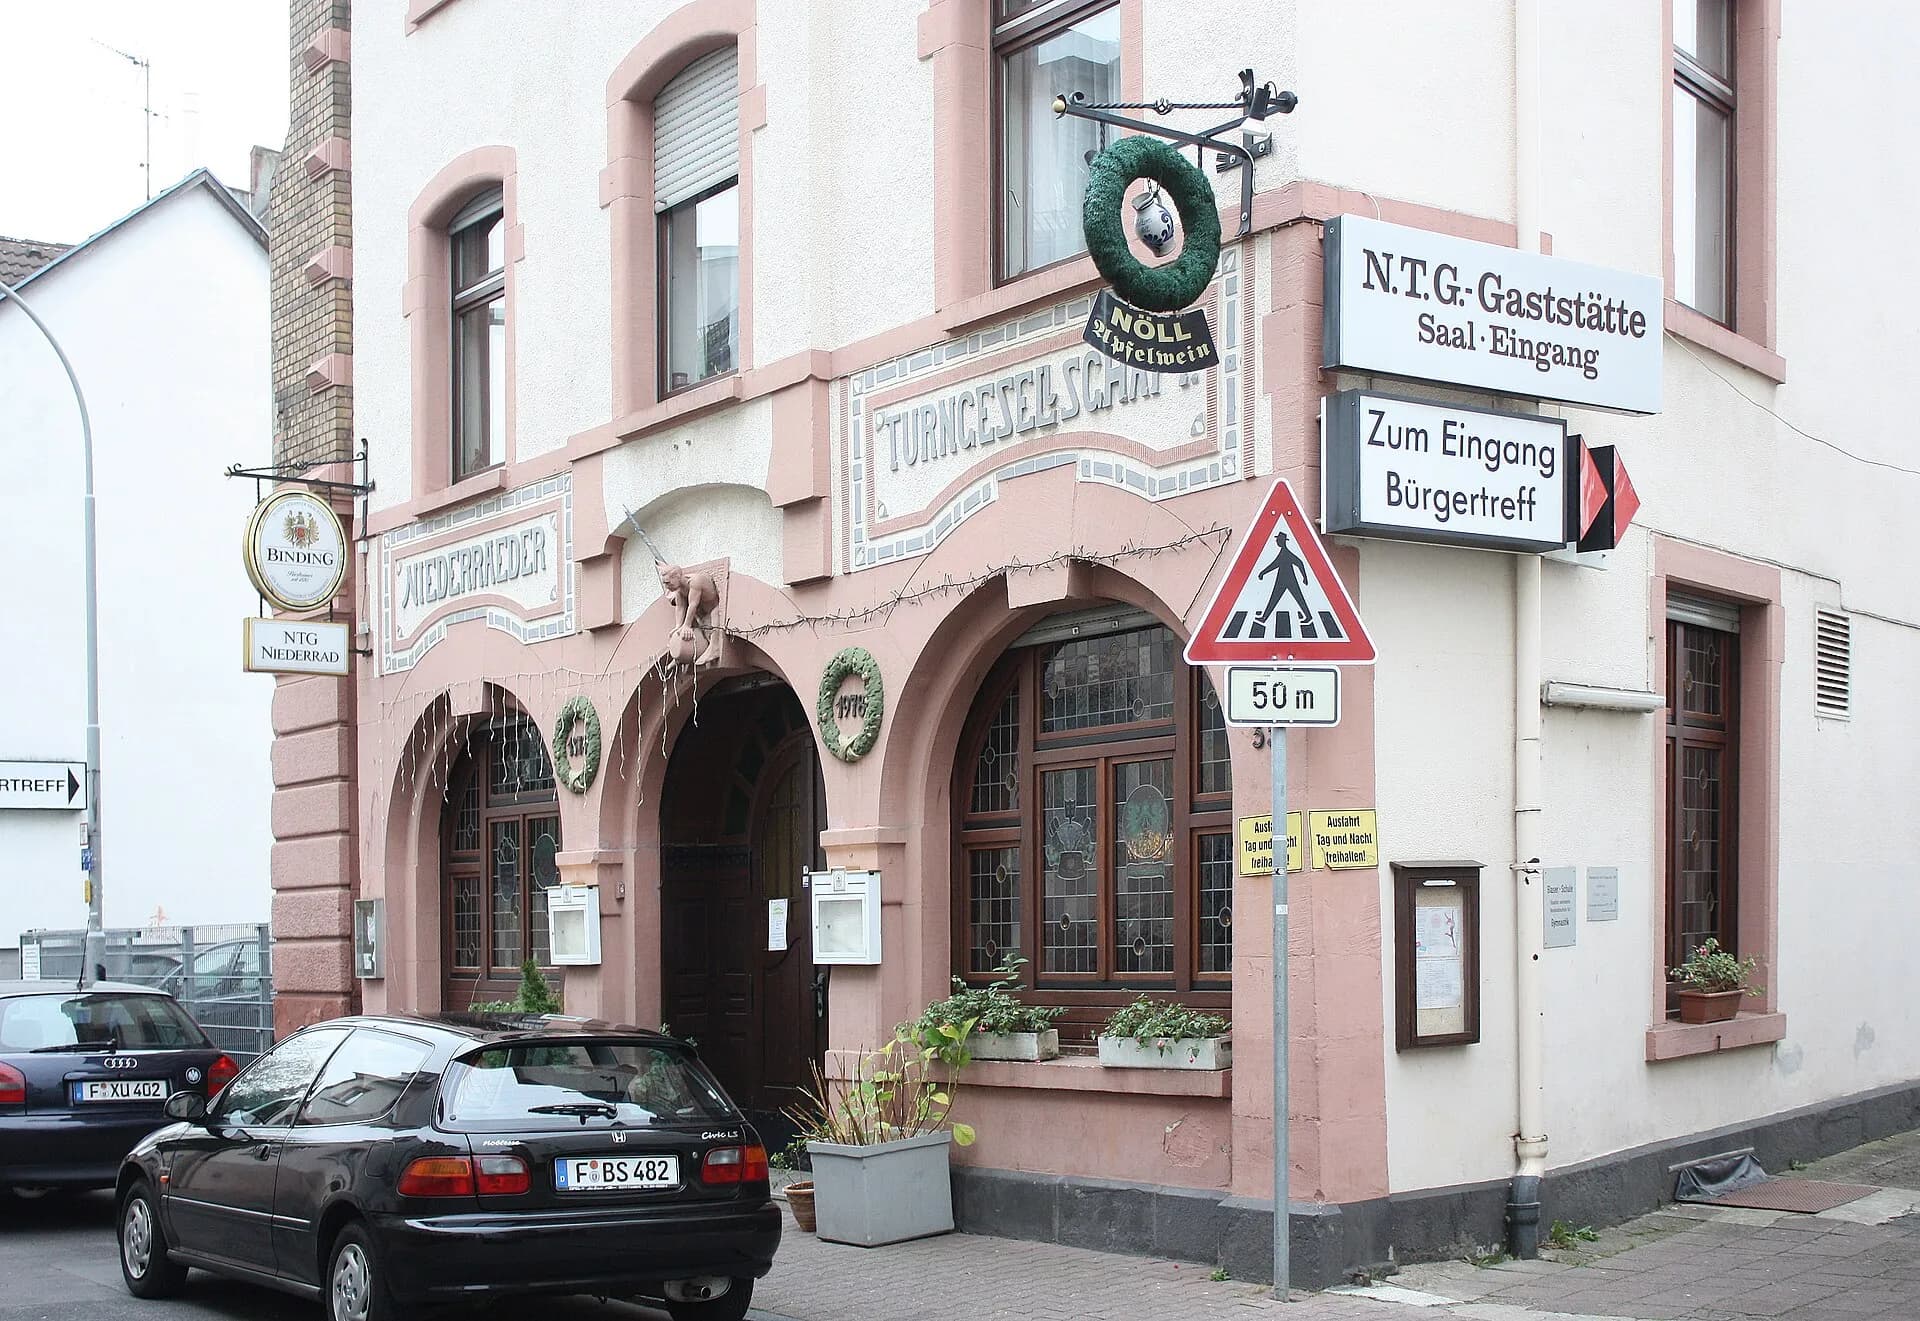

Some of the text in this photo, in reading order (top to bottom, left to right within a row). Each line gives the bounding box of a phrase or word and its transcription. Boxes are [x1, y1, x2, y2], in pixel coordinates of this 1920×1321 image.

[1110, 306, 1192, 343] NÖLL
[1091, 318, 1211, 367] Apfelwein
[1418, 312, 1600, 380] Saal Eingang
[1367, 409, 1555, 479] Zum Eingang
[1386, 470, 1537, 523] Bürgertreff
[401, 525, 547, 609] NIEDERRAEDER
[283, 631, 318, 646] NTG
[1252, 681, 1315, 710] 50 m
[1327, 815, 1360, 828] Ausfahrt
[1244, 840, 1257, 853] Tag
[1258, 838, 1273, 851] und
[1316, 832, 1373, 847] Tag und Nacht
[1326, 849, 1367, 863] freihalten!
[90, 1082, 161, 1098] F XU 402
[701, 1130, 727, 1140] Civic
[576, 1160, 670, 1184] F BS 482
